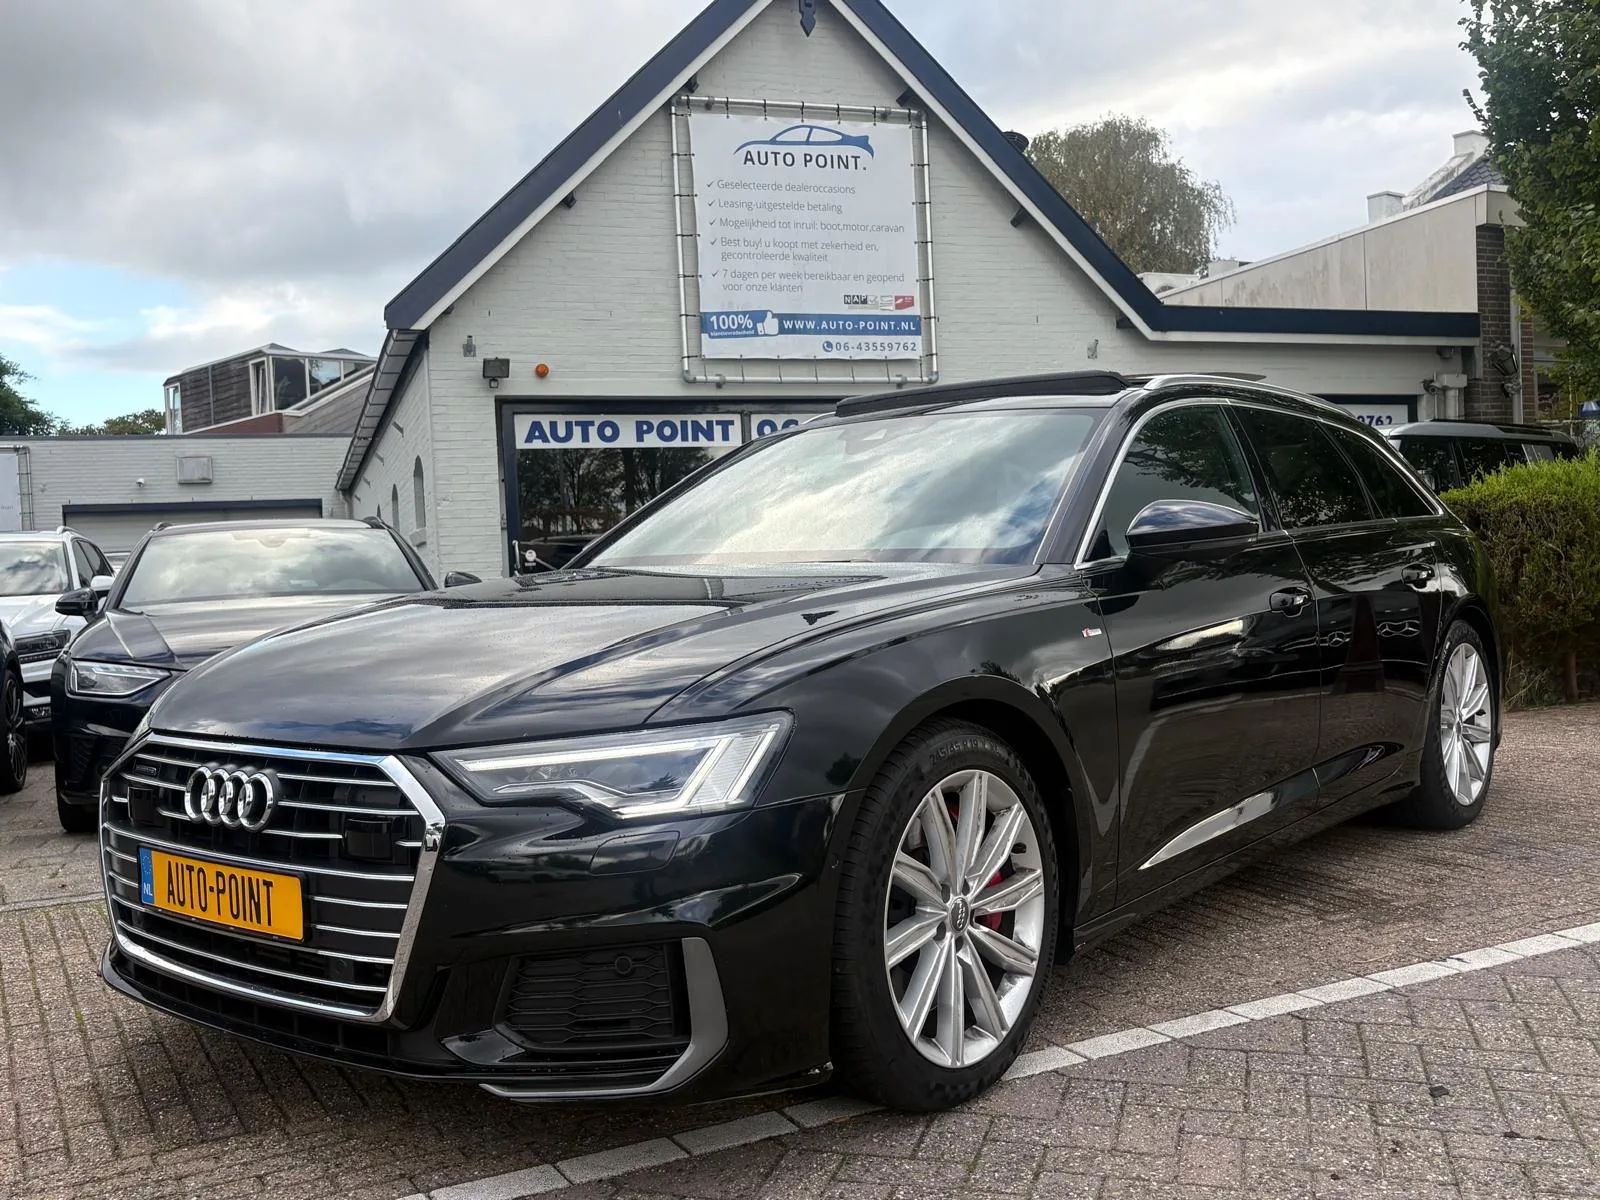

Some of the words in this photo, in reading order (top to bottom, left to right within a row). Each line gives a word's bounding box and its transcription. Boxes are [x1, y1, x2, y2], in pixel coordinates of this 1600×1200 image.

[743, 150, 795, 167] AUTO
[717, 179, 783, 192] Geselecteerde
[785, 182, 856, 194] dealeroccasions
[807, 201, 843, 214] betaling
[720, 217, 776, 230] Mogelijkheid
[779, 220, 791, 229] tot
[793, 220, 818, 230] inruil:
[720, 236, 741, 247] Best
[743, 238, 762, 250] buy!
[764, 240, 771, 248] u
[773, 238, 799, 250] koopt
[801, 241, 820, 250] met
[821, 241, 863, 251] zekerheid
[721, 251, 791, 262] gecontroleerde
[792, 252, 829, 262] kwaliteit
[722, 269, 728, 278] 7
[730, 269, 759, 281] dagen
[761, 272, 776, 281] per
[778, 271, 803, 280] week
[804, 271, 851, 281] bereikbaar
[866, 273, 905, 285] geopend
[722, 283, 743, 291] voor
[745, 283, 768, 292] onze
[770, 282, 803, 292] klanten
[844, 295, 867, 304] NAP
[710, 314, 754, 330] 100%
[783, 319, 916, 331] WWW.AUTO-POINT.NL
[835, 342, 917, 352] 06-43559762
[524, 420, 620, 444] AUTO
[636, 419, 735, 443] POINT
[143, 882, 153, 897] NL
[167, 860, 273, 927] AUTO-POINT
